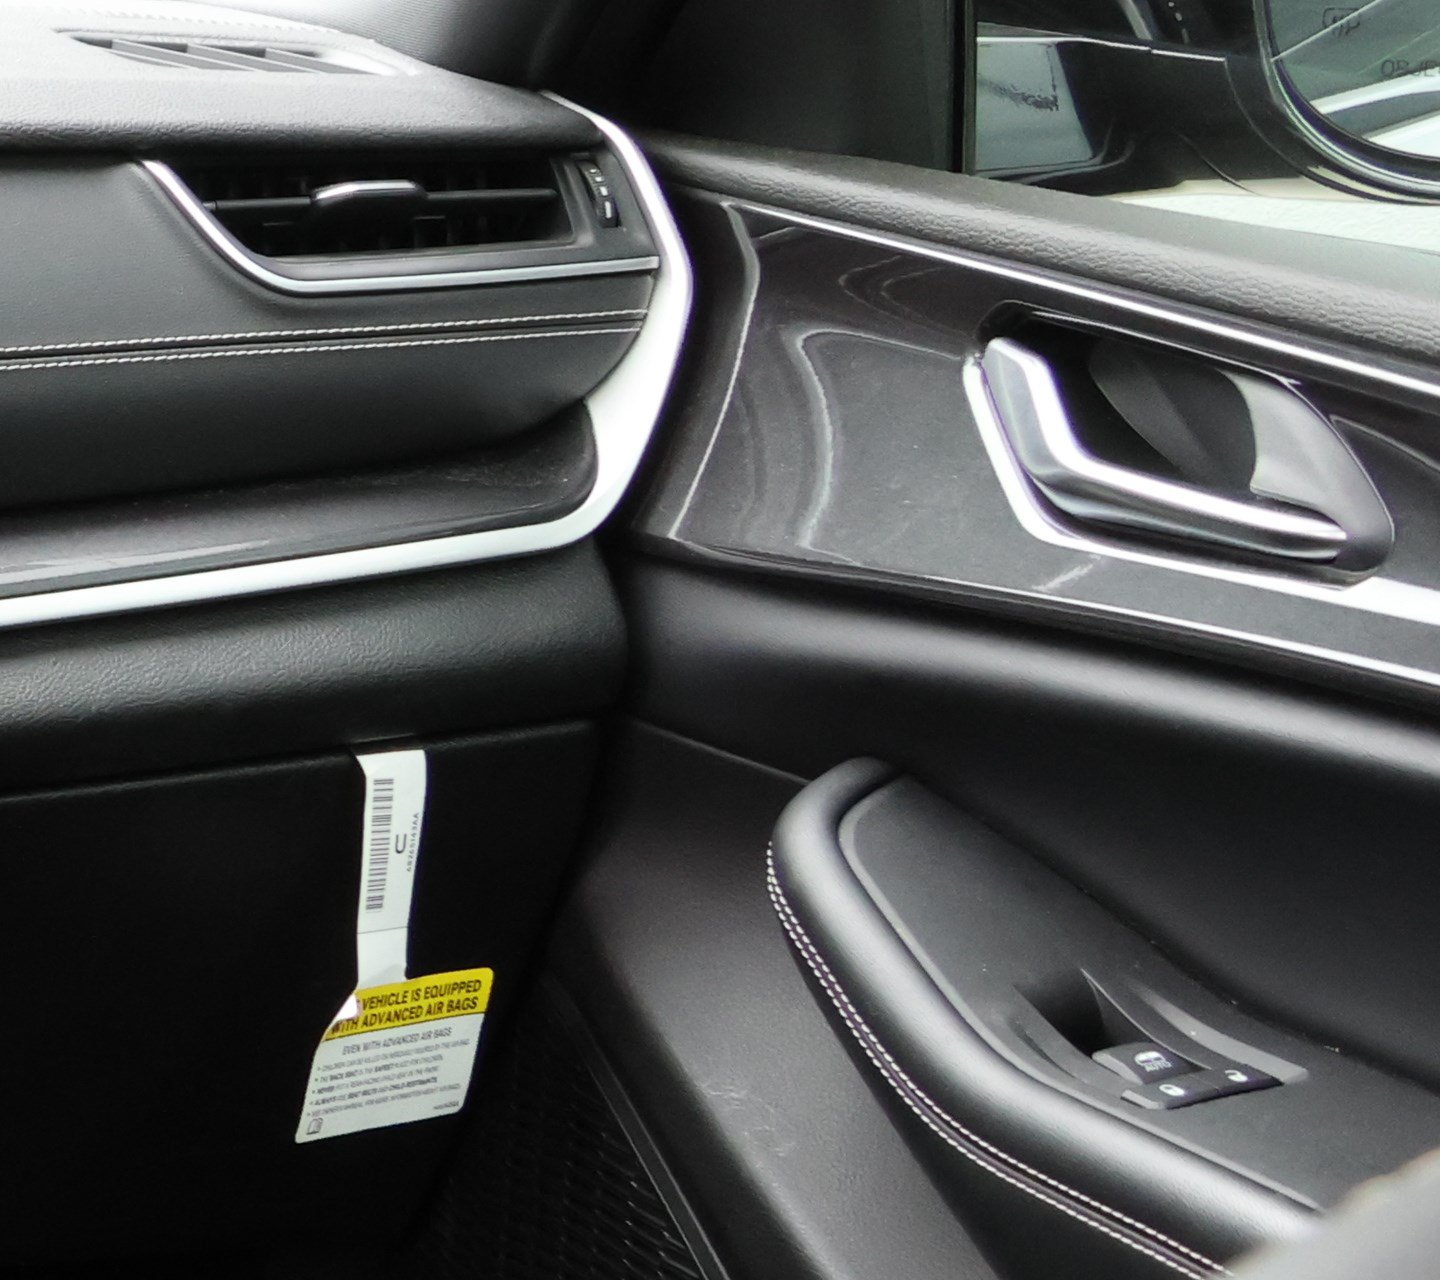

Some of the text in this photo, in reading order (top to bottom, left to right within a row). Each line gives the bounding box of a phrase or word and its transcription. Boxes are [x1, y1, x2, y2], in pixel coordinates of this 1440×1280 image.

[361, 979, 482, 1011] VEHICLE IS EQUIPPED
[361, 1006, 423, 1028] ADVANCED
[425, 1001, 445, 1016] AIR
[446, 996, 479, 1013] BAGS
